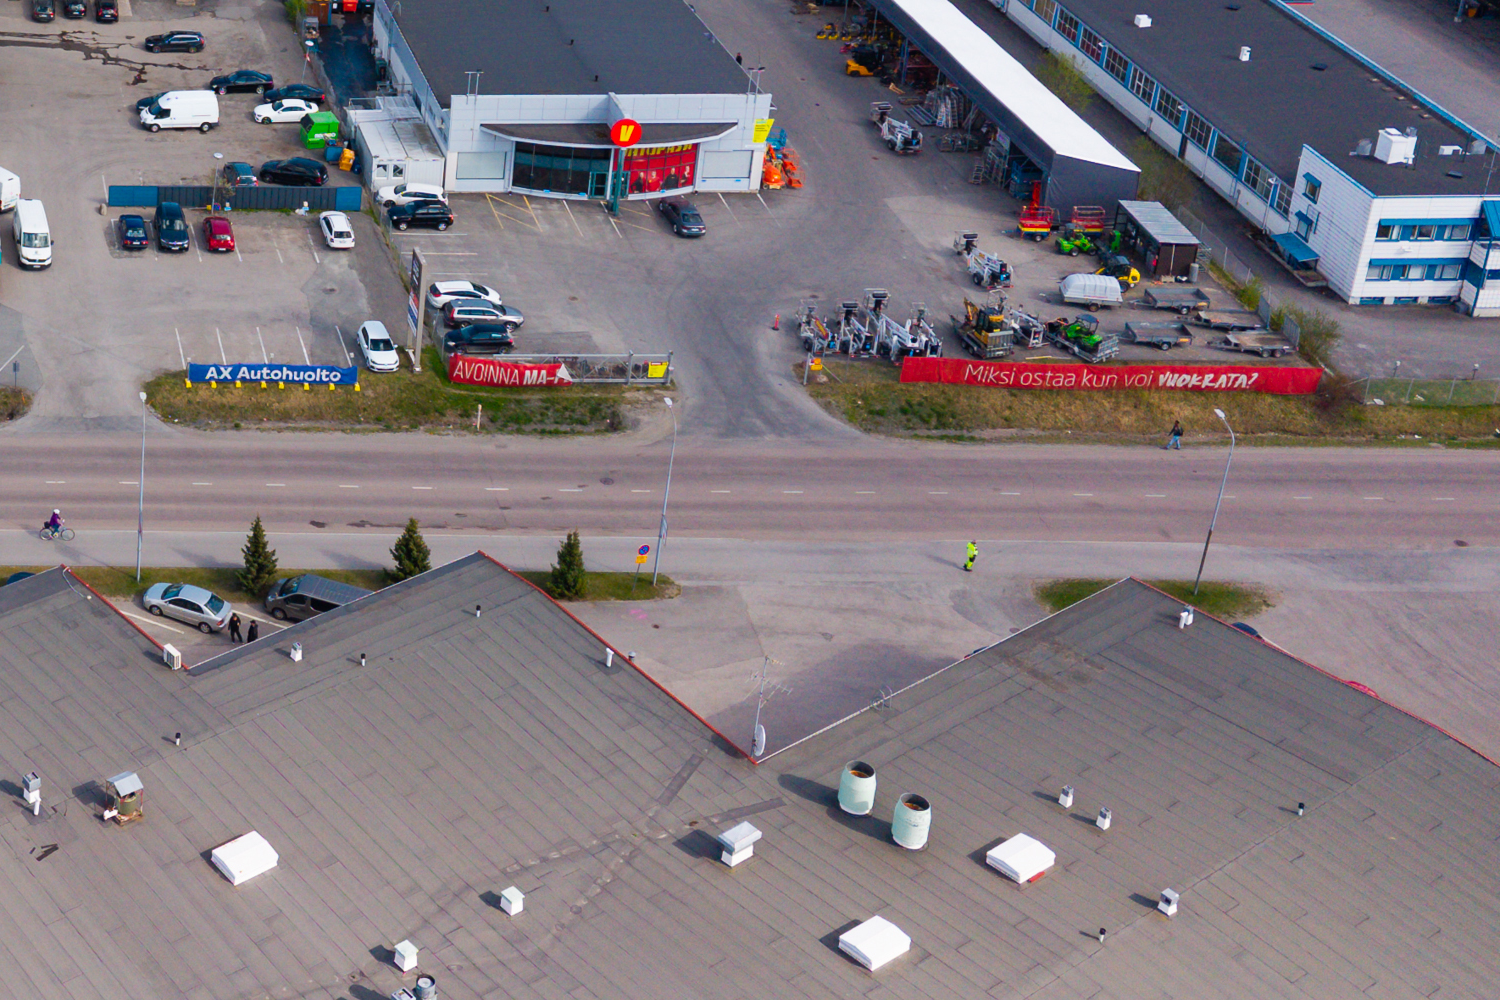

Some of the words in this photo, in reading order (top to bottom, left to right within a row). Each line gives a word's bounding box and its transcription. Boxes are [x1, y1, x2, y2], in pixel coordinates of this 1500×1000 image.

[619, 125, 634, 142] V
[205, 366, 233, 380] AX
[237, 366, 342, 382] Autohuolto
[453, 360, 520, 385] AVOINNA
[964, 364, 1017, 386] Miksi
[1020, 370, 1076, 387] ostaa
[1081, 369, 1119, 388] kun
[1124, 370, 1155, 387] voi
[1158, 371, 1259, 389] VUOKRATA?
